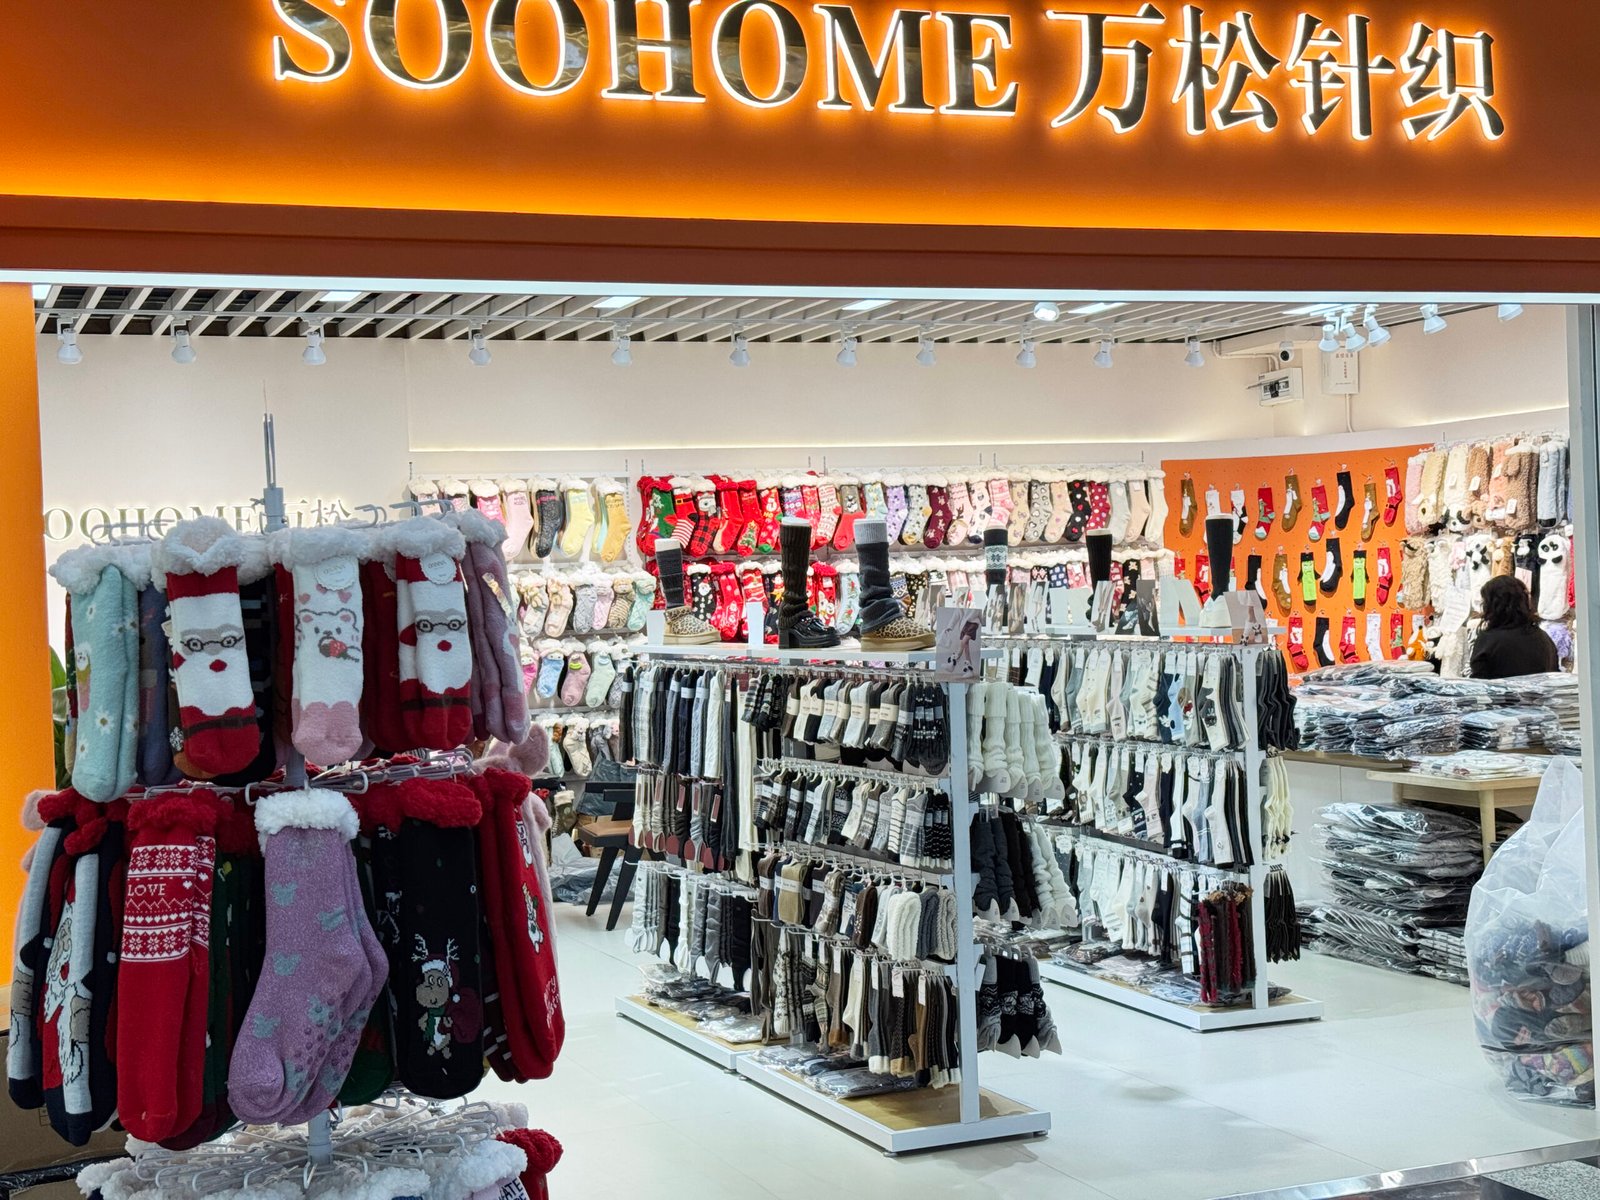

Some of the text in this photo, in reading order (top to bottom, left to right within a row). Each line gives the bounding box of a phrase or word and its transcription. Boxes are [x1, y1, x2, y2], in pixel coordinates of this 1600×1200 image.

[273, 0, 1505, 141] SOOHOME 万松针织
[127, 883, 166, 897] LOVE
